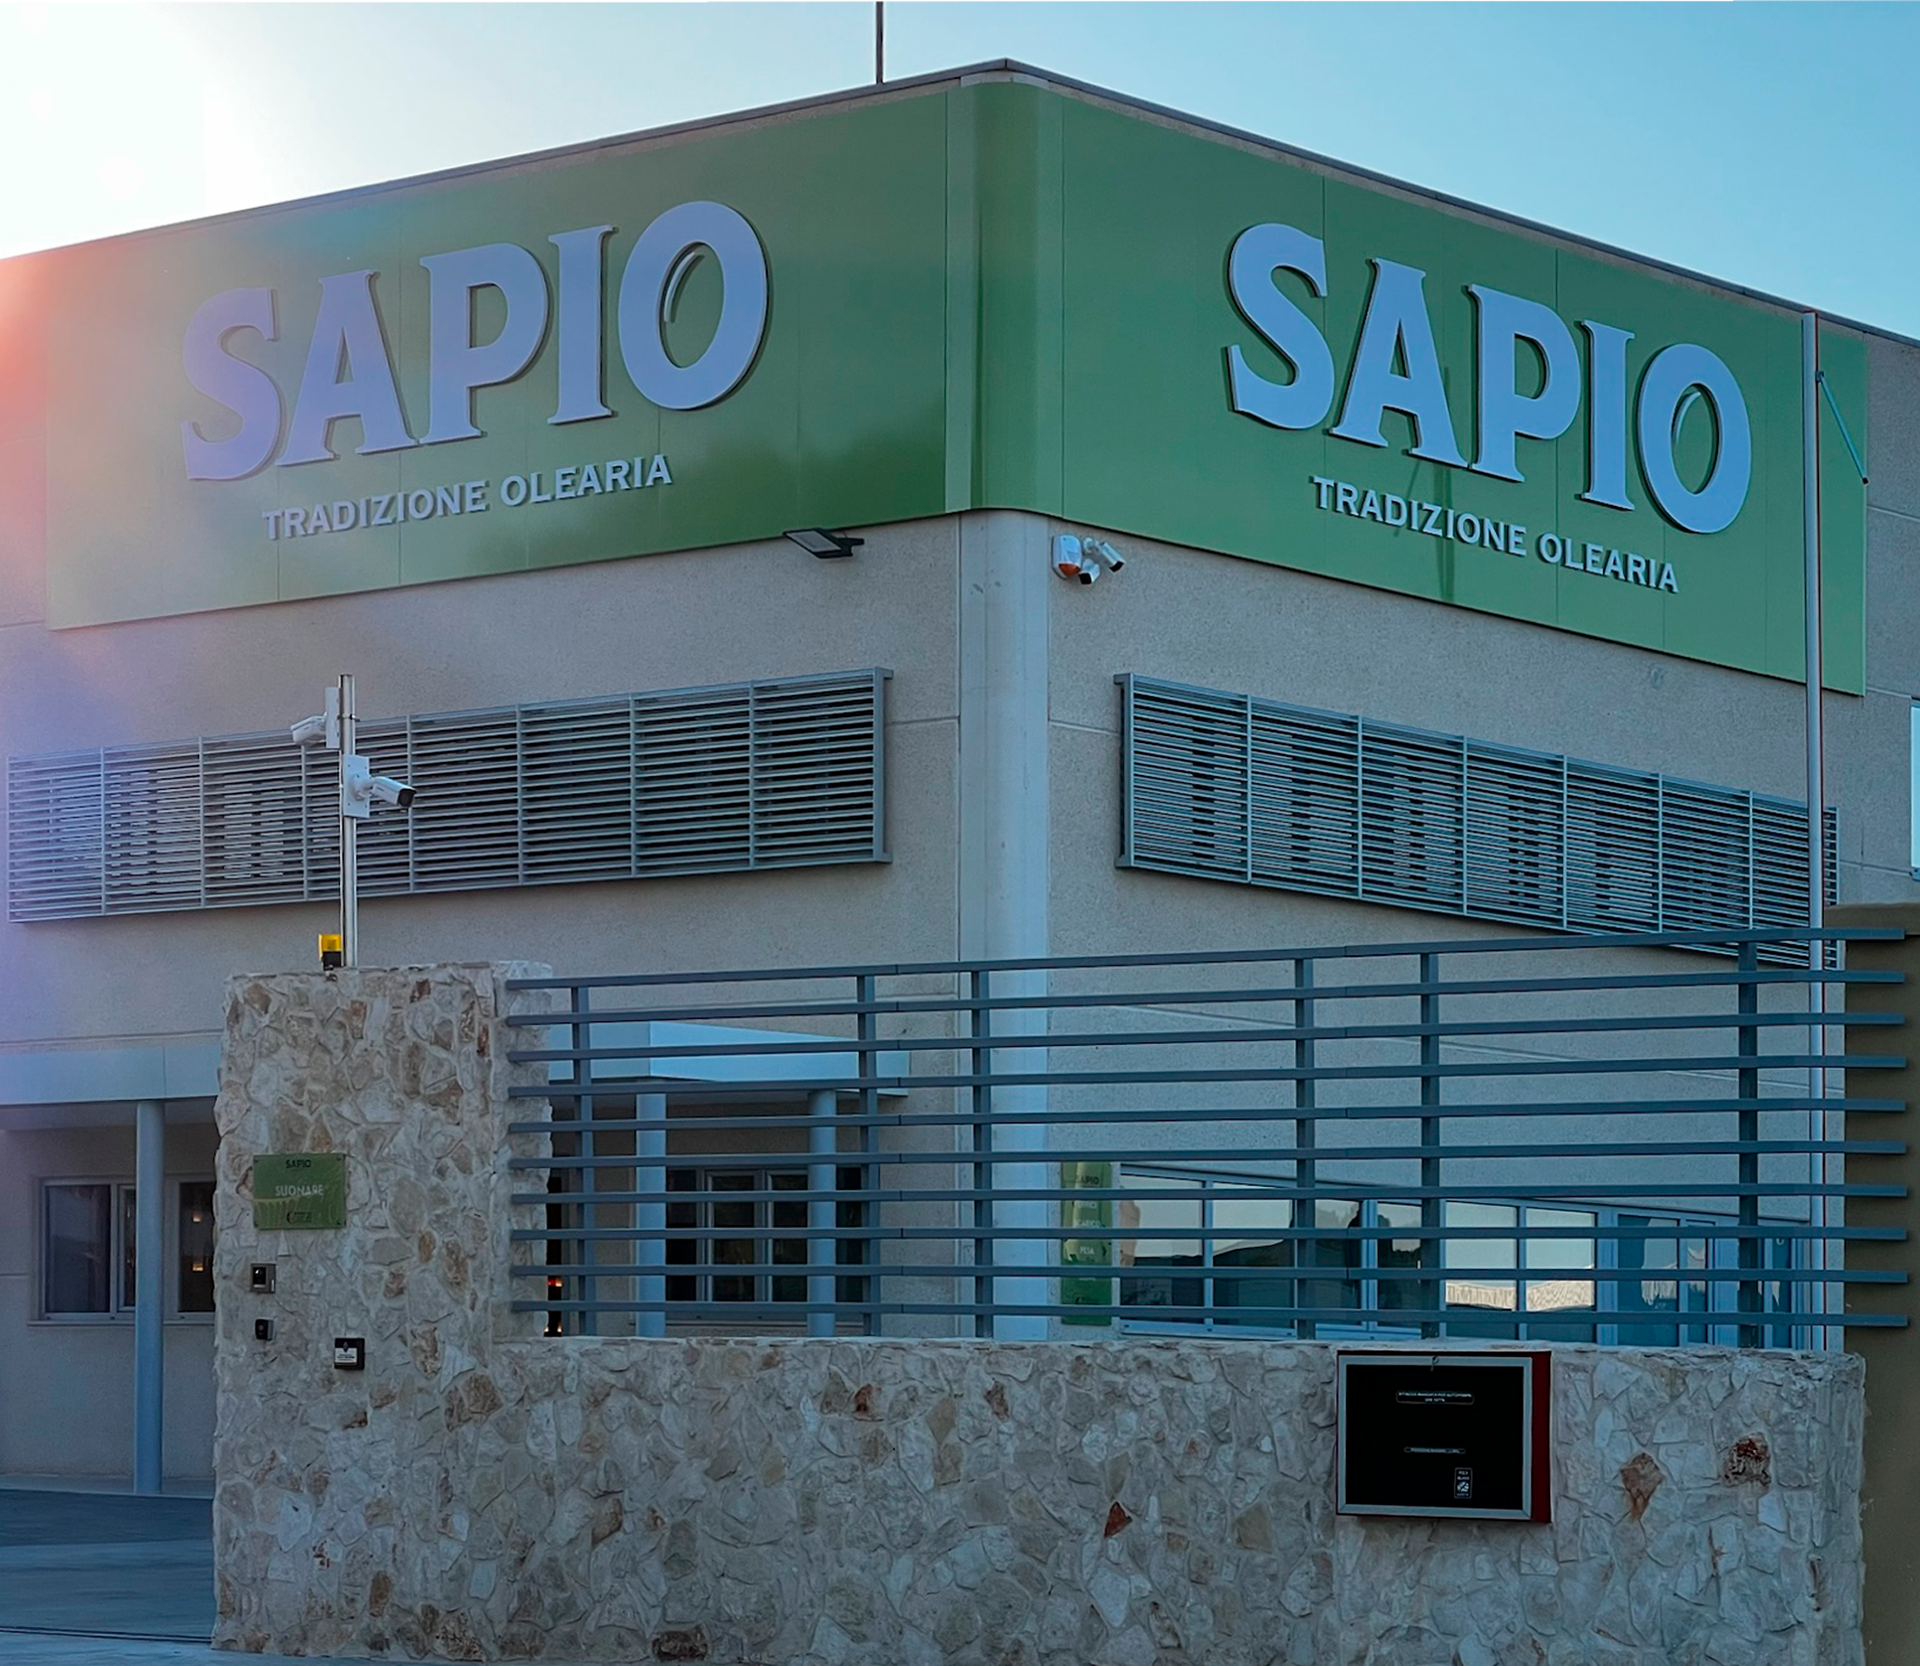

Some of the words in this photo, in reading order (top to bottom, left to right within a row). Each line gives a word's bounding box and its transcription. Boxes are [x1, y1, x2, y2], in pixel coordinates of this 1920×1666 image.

[181, 200, 768, 482] SAPIO
[1224, 222, 1752, 534] SAPIO
[262, 480, 489, 540] TRADIZIONE
[500, 454, 673, 507] OLEARIA
[1311, 475, 1527, 556] TRADIZIONE
[1538, 533, 1679, 593] OLEARIA
[275, 1184, 325, 1197] SUONARE
[285, 1159, 312, 1169] SAPIO
